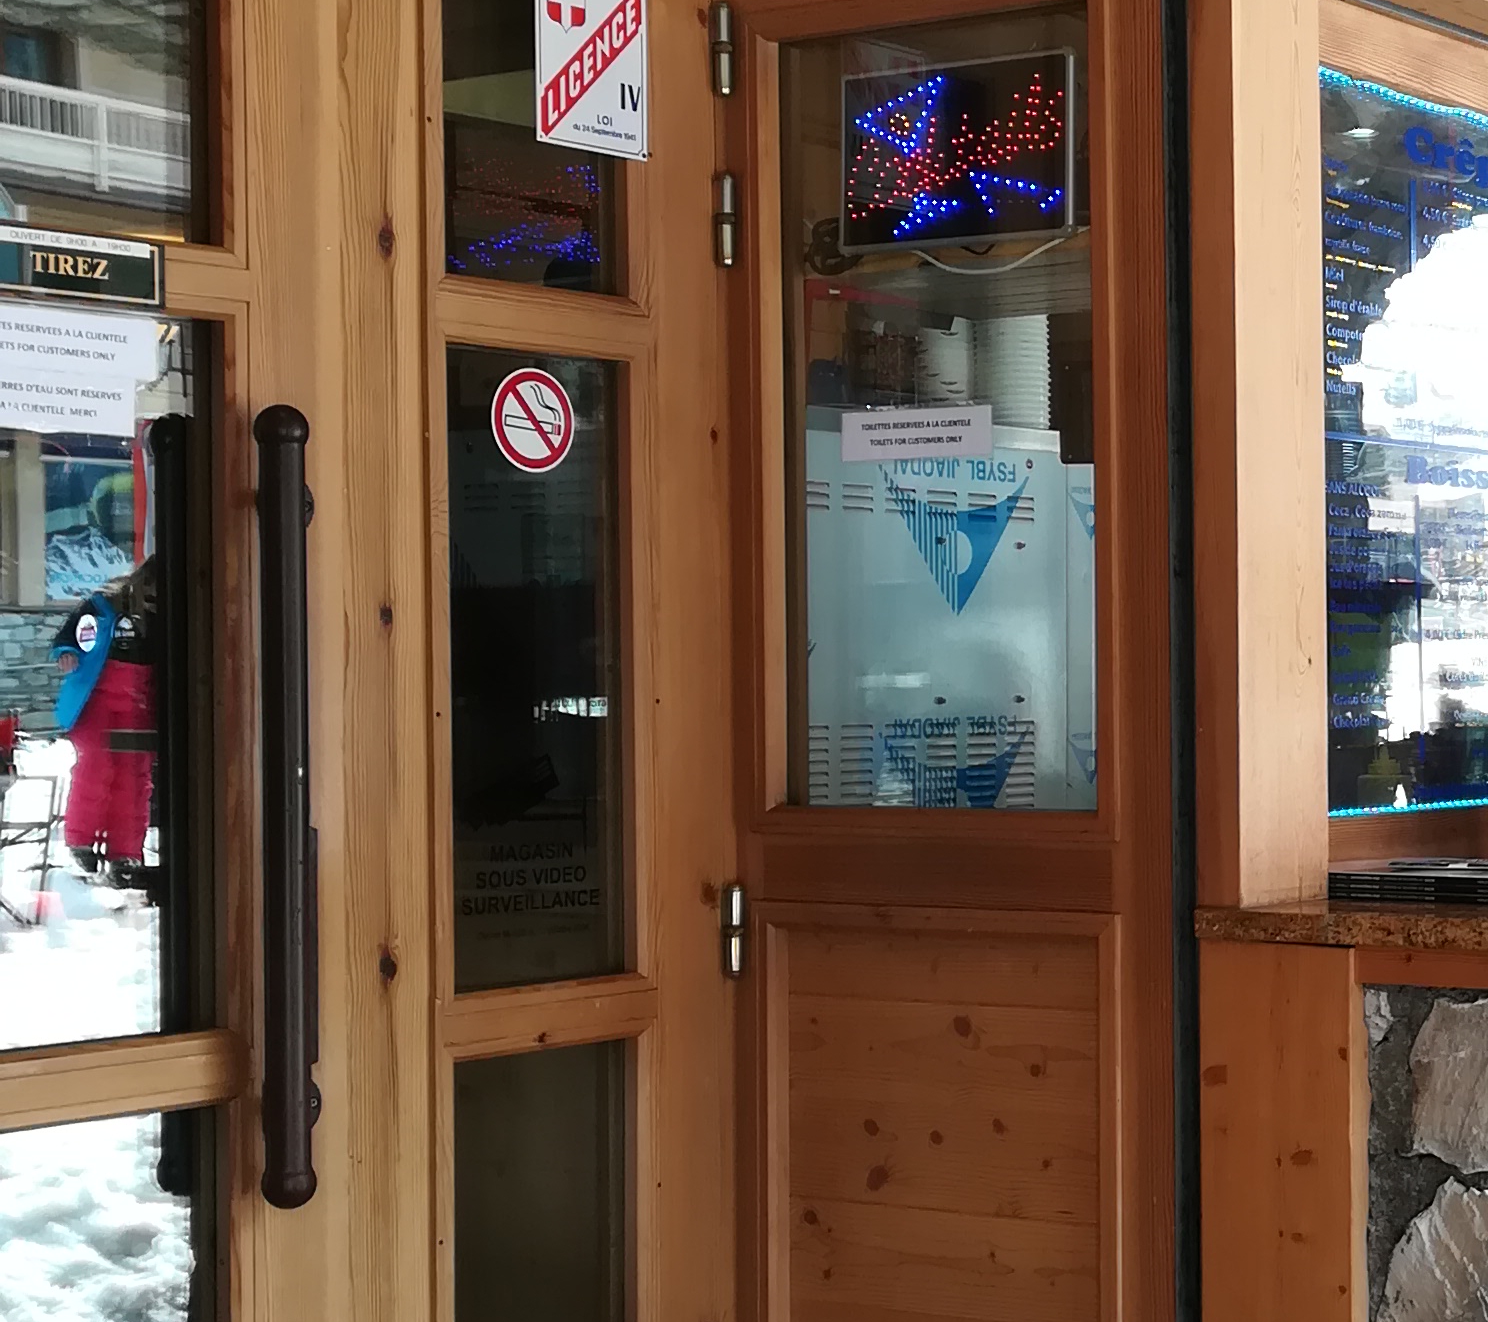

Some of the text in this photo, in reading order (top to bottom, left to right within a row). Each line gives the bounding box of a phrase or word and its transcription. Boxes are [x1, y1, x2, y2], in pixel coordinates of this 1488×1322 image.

[620, 82, 641, 112] IV
[596, 114, 613, 127] LOI
[9, 230, 46, 242] OUVERT
[51, 235, 62, 243] DE
[29, 250, 110, 280] TIREZ
[14, 323, 63, 336] RESERVEES
[64, 328, 72, 337] A
[72, 330, 84, 339] LA
[85, 331, 128, 344] CLIENTELE
[17, 343, 36, 352] FOR
[37, 345, 91, 359] CUSTOMERS
[92, 351, 116, 361] ONLY
[26, 383, 53, 394] D'EAU
[55, 386, 79, 397] SONT
[80, 389, 122, 401] RESERVES
[1326, 380, 1357, 396] Nutella
[940, 419, 972, 427] CLIENTELE
[870, 435, 963, 446] TOILETS FOR CUSTOMERS ONLY
[966, 459, 1017, 483] FSYBL
[490, 843, 574, 862] MAGASIN
[476, 865, 587, 889] SOUS VIDEO
[462, 889, 600, 916] SURVEILLANCE
